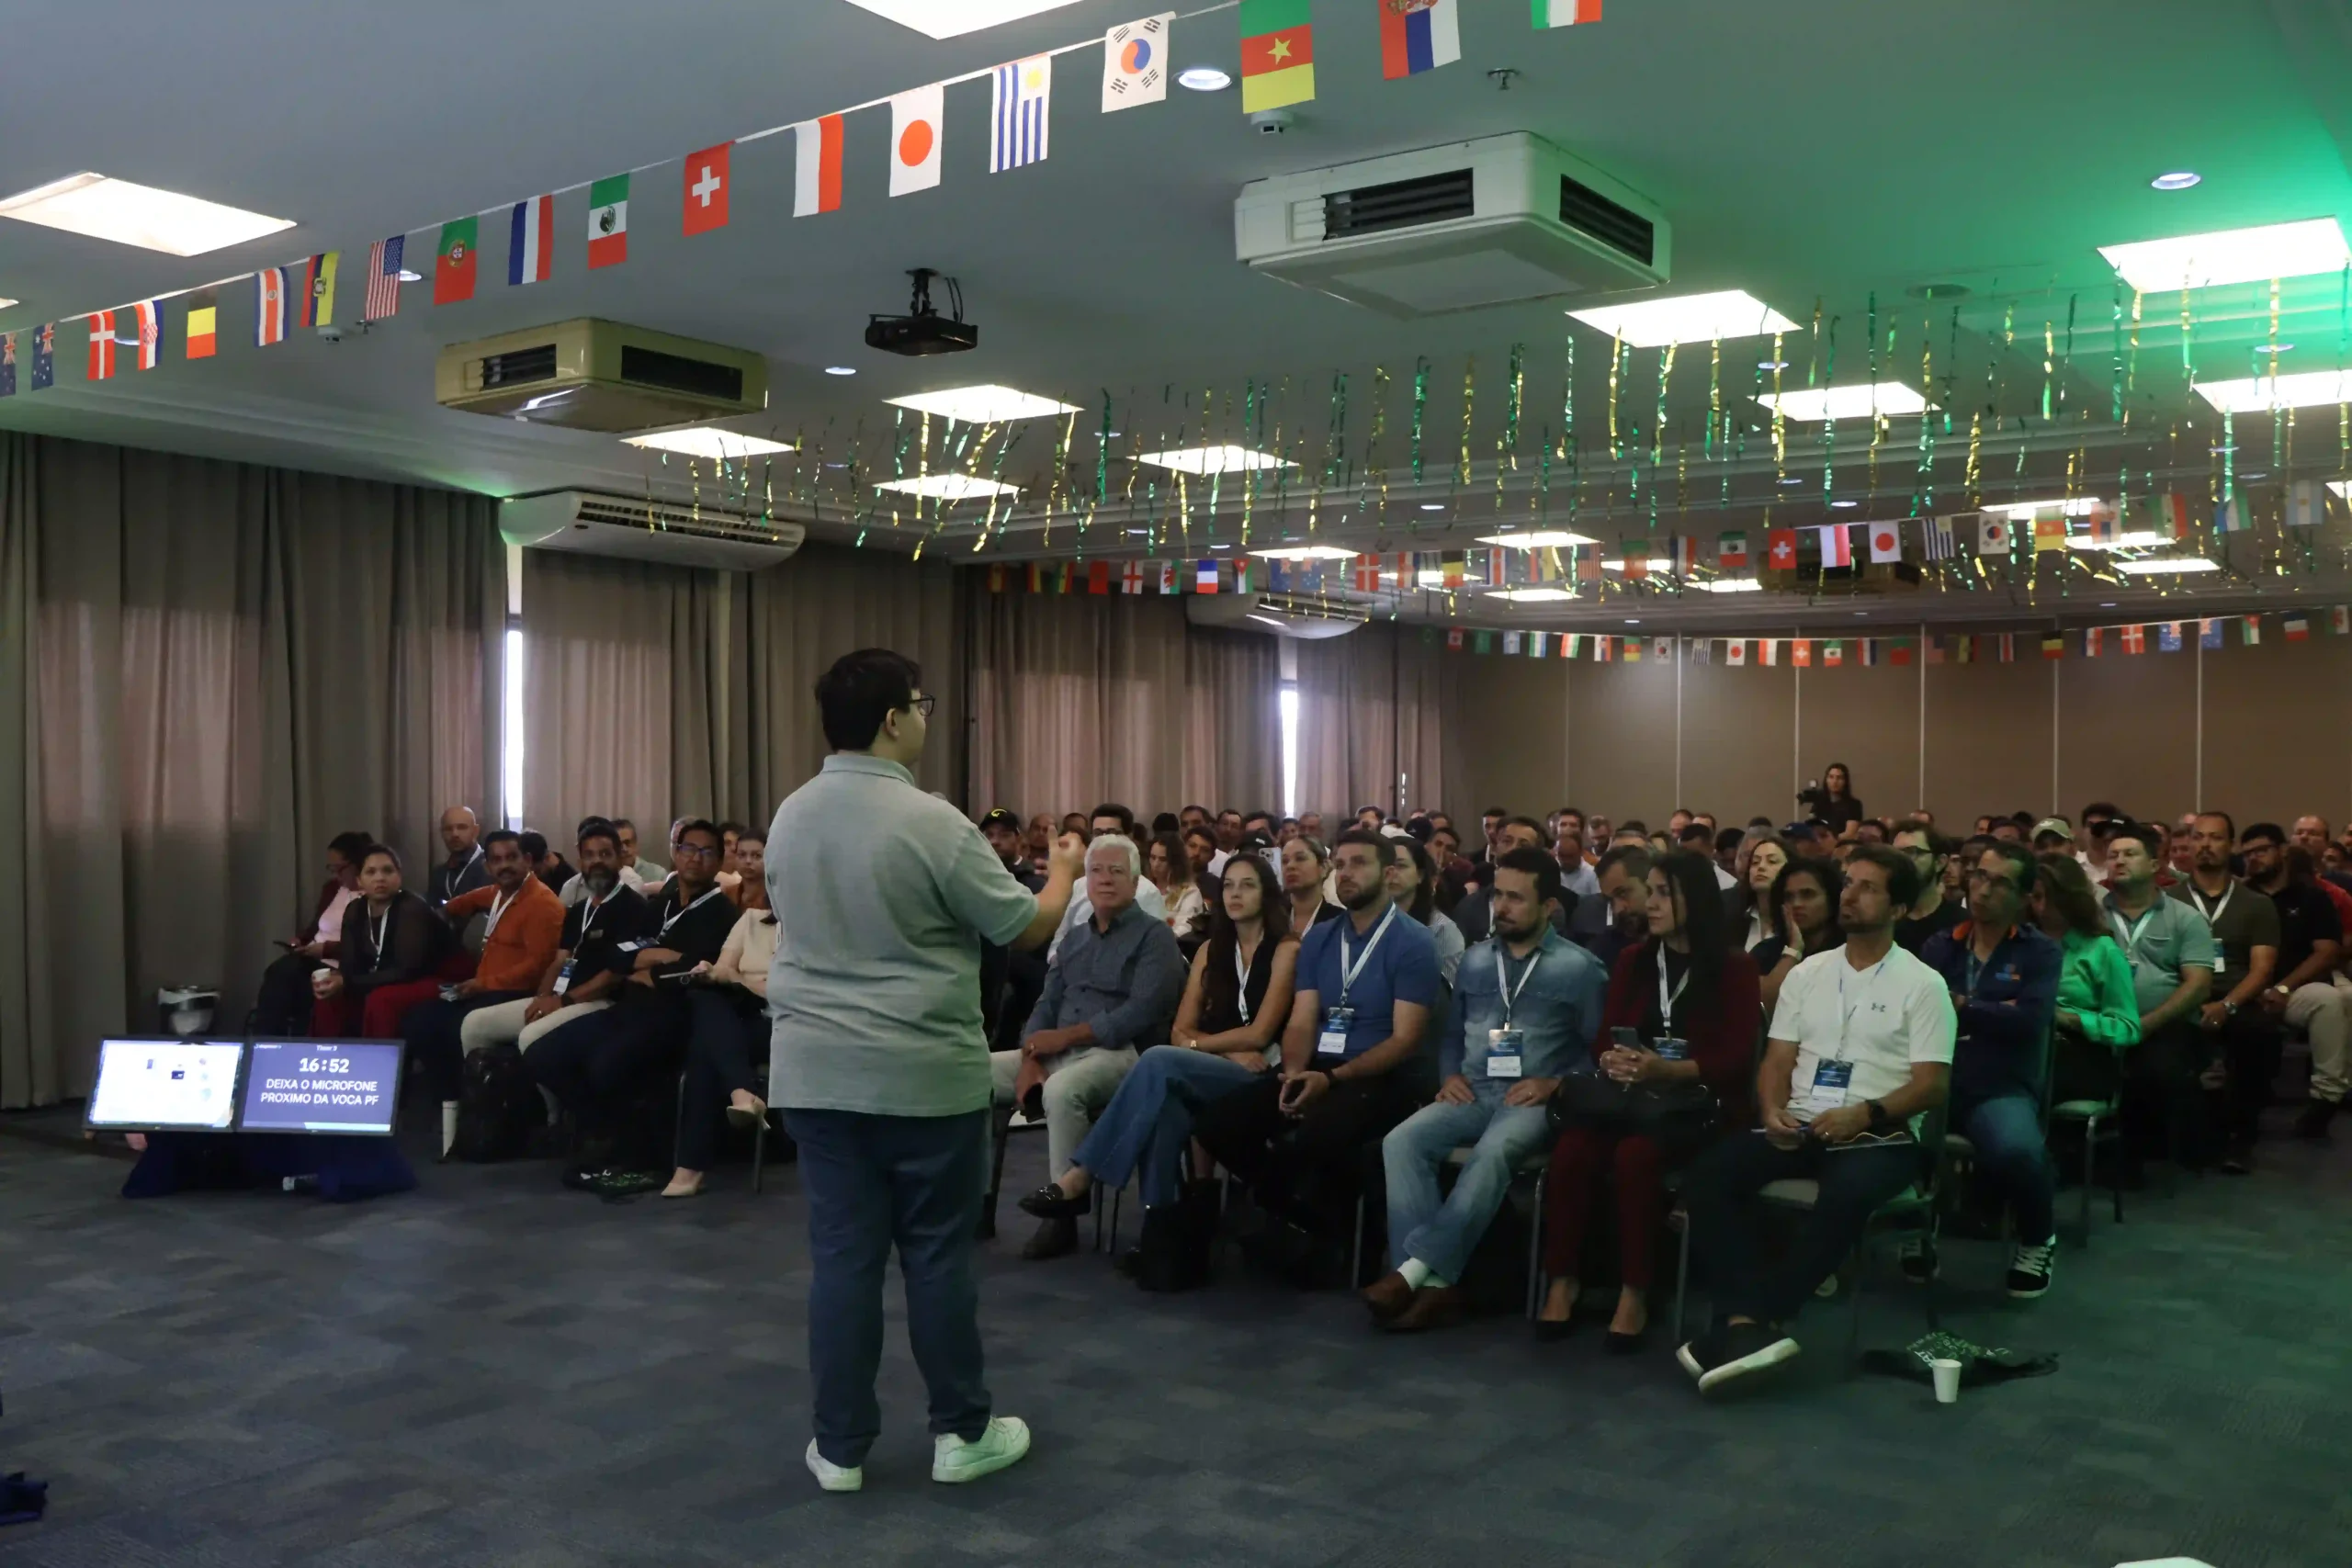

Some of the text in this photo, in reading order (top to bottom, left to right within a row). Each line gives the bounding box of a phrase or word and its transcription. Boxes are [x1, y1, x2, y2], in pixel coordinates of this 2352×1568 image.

[299, 1057, 350, 1074] 16:52
[266, 1078, 379, 1092] DEIXA O MICROFONE
[260, 1092, 379, 1106] PROXIMO DA VOCA PF
